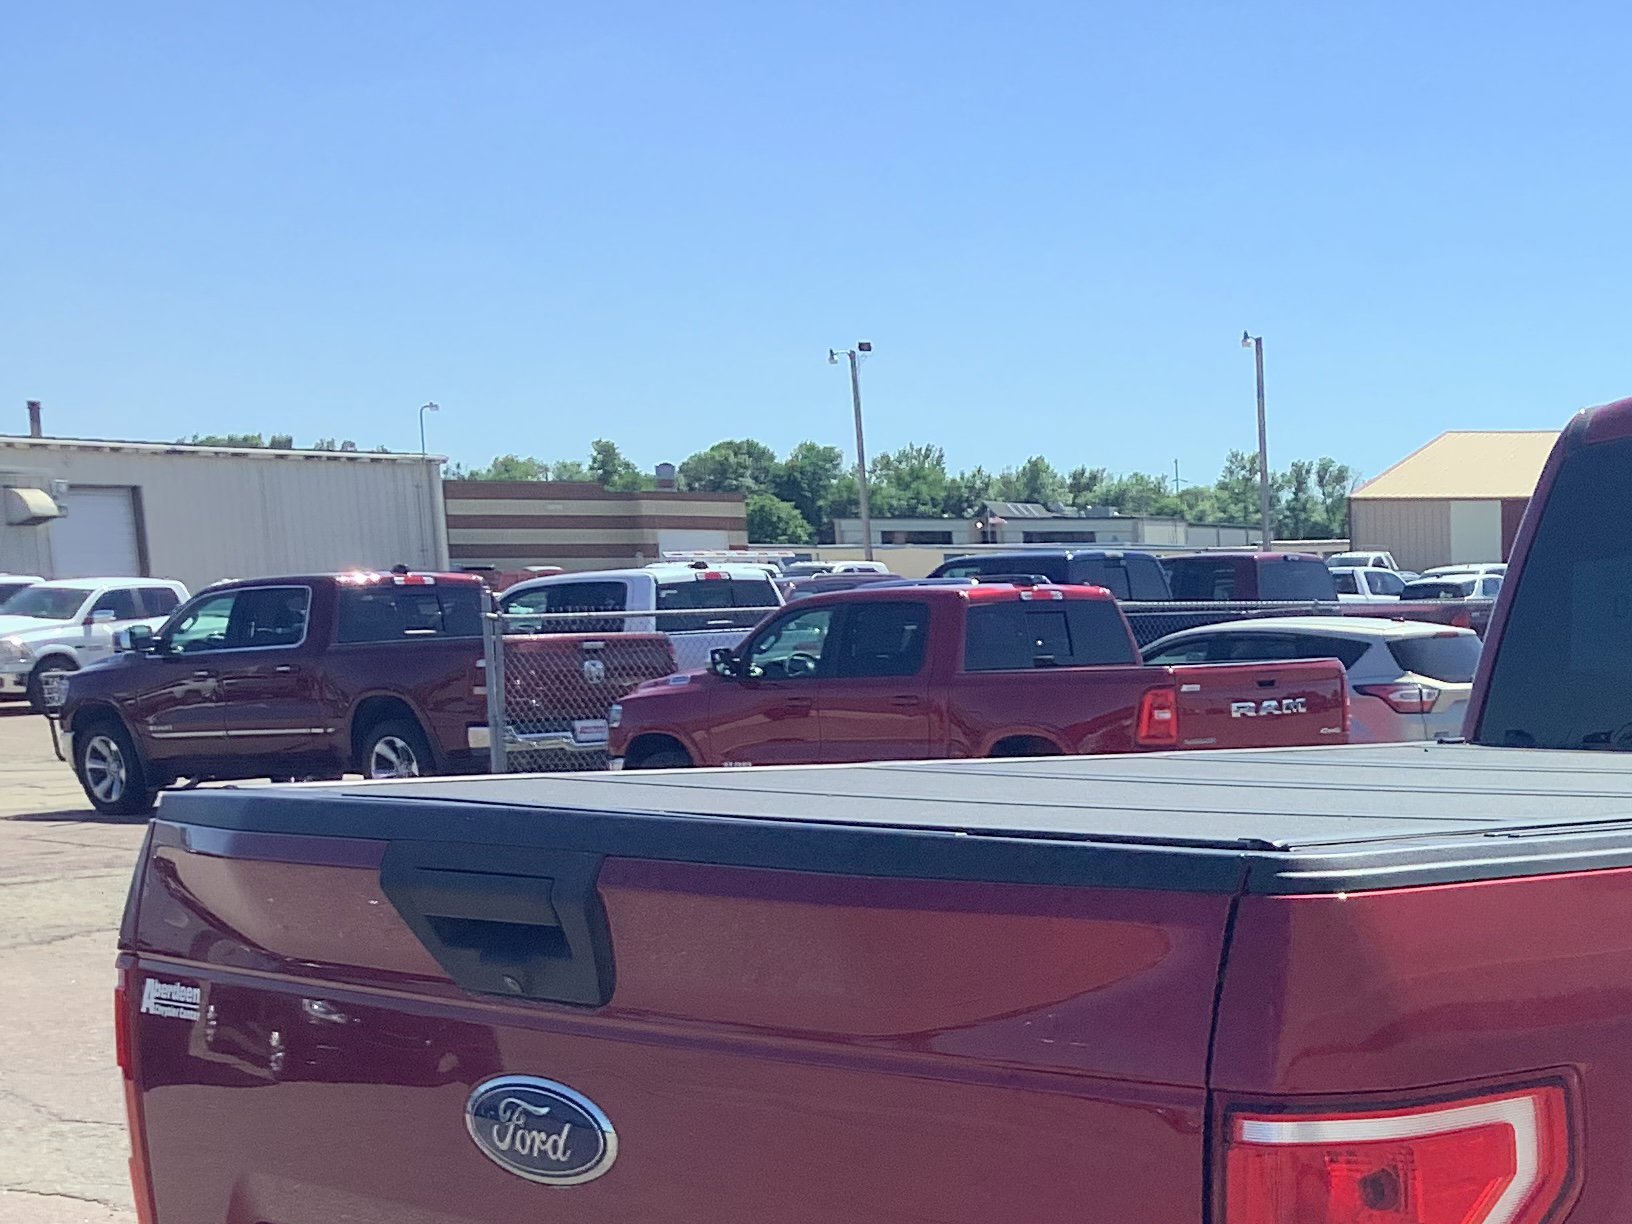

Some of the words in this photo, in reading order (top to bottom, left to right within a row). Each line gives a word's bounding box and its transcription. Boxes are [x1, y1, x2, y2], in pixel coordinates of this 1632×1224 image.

[1231, 697, 1307, 718] RAM
[140, 978, 201, 1013] Aberdeen
[493, 1097, 572, 1162] Ford
